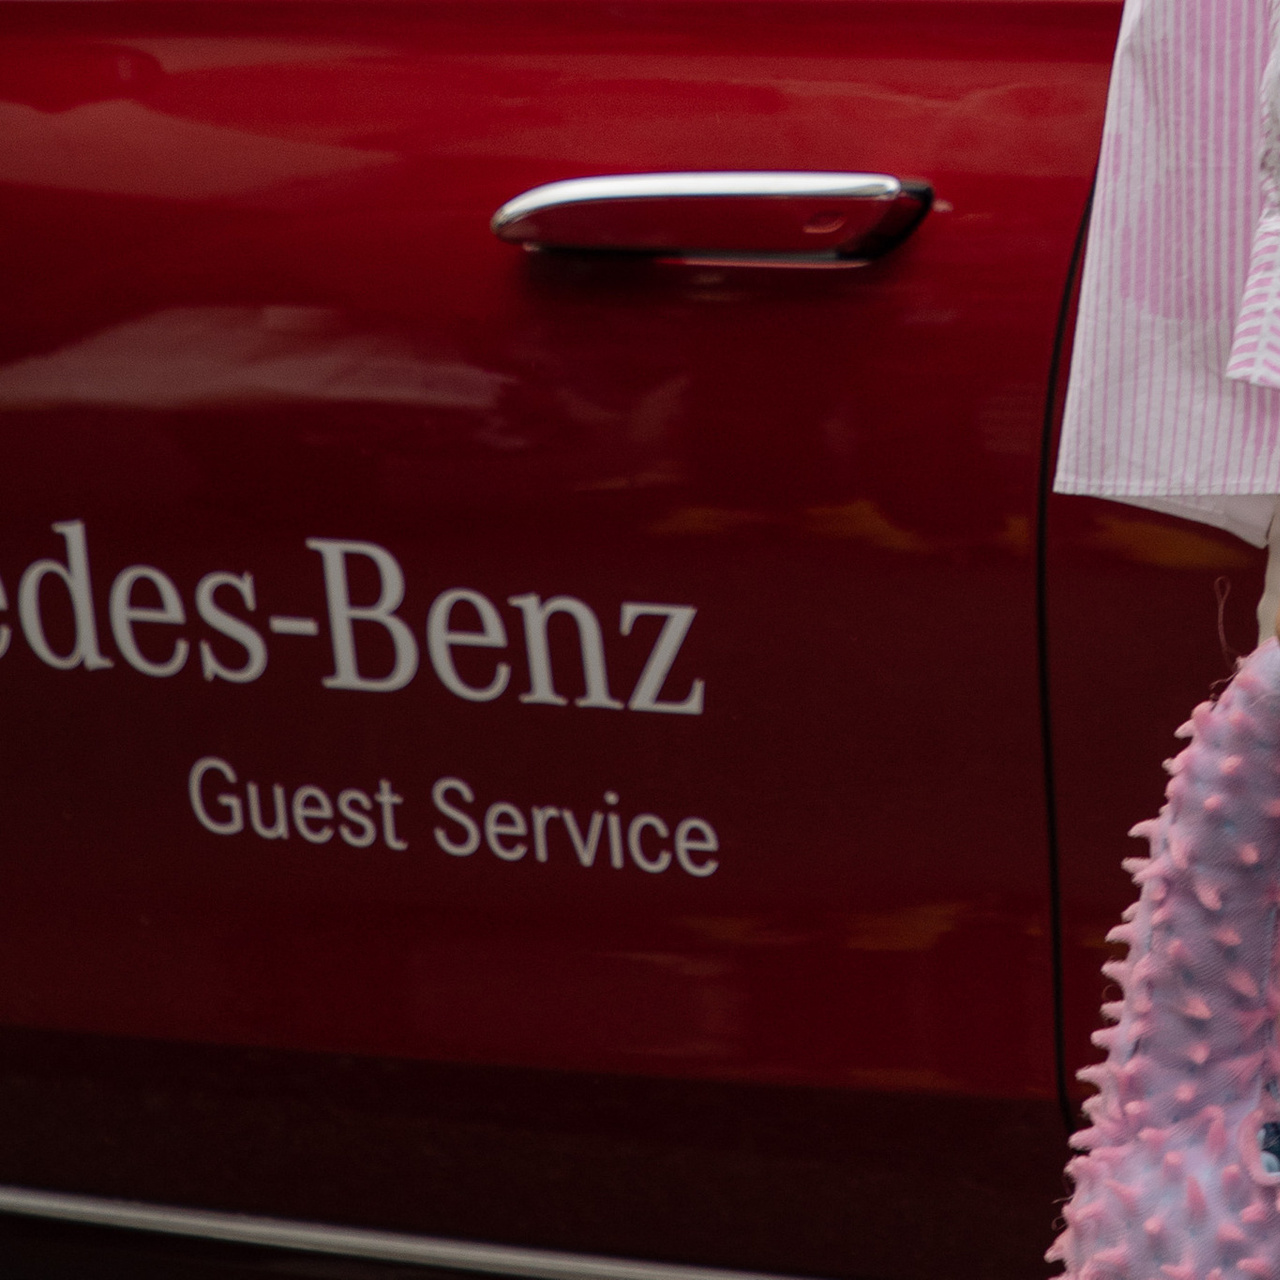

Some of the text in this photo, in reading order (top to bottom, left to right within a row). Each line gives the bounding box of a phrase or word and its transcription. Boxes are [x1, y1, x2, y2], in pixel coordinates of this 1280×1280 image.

[0, 520, 704, 714] des-Benz
[189, 757, 719, 876] Guest Service
